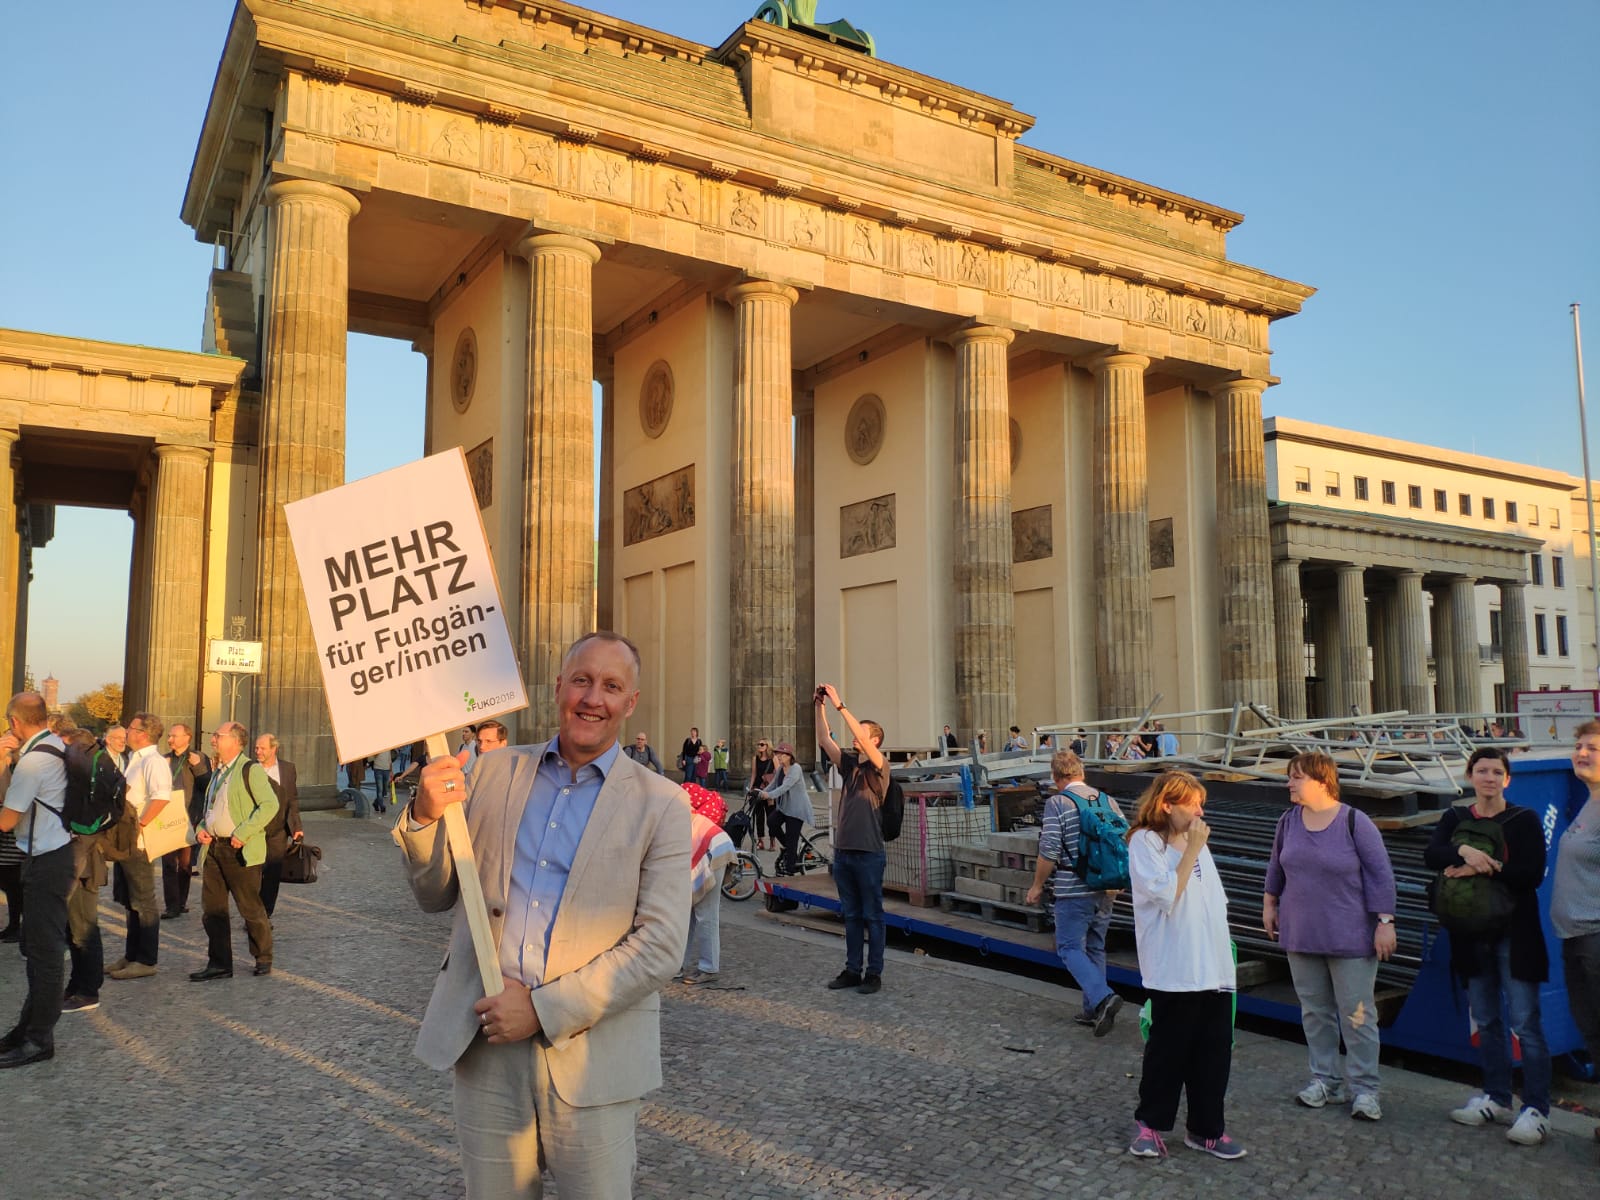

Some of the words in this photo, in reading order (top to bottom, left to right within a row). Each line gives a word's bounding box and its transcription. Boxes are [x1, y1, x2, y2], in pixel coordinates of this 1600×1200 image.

[324, 519, 461, 592] MEHR
[329, 555, 476, 632] PLATZ
[325, 640, 366, 669] für
[374, 604, 495, 655] Fußgän-
[350, 632, 487, 696] ger/innen
